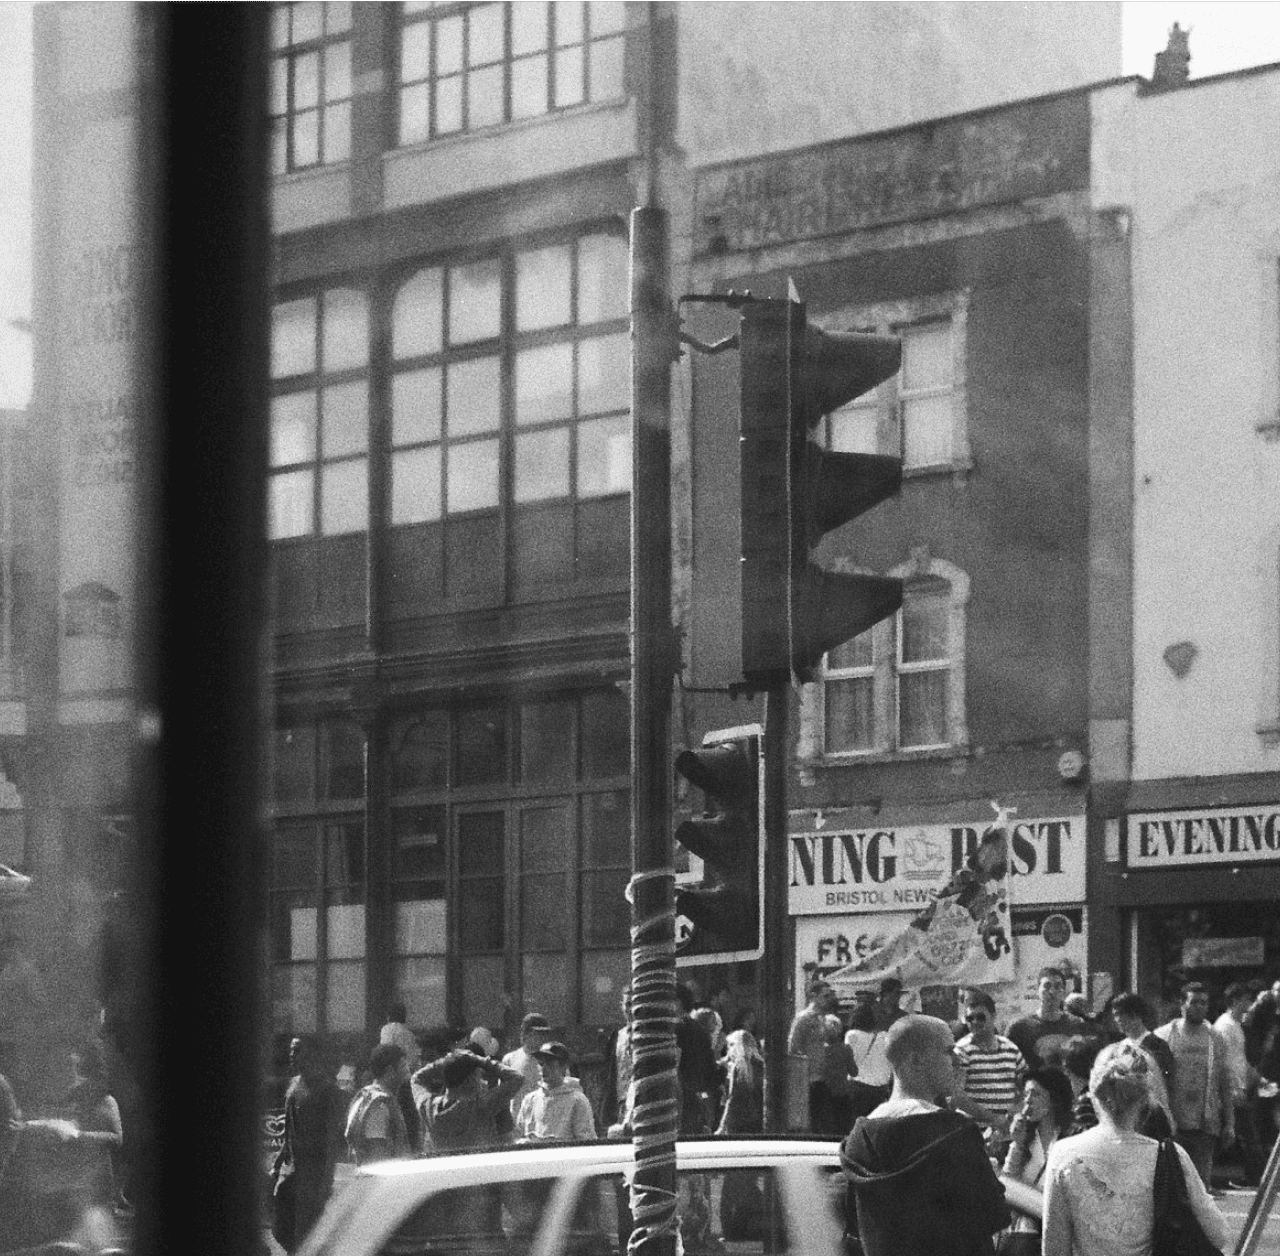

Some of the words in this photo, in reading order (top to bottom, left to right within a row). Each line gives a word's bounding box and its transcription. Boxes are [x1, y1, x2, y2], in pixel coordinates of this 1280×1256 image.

[790, 831, 896, 886] NING
[951, 820, 1071, 877] PST
[825, 887, 886, 905] BRISTOL
